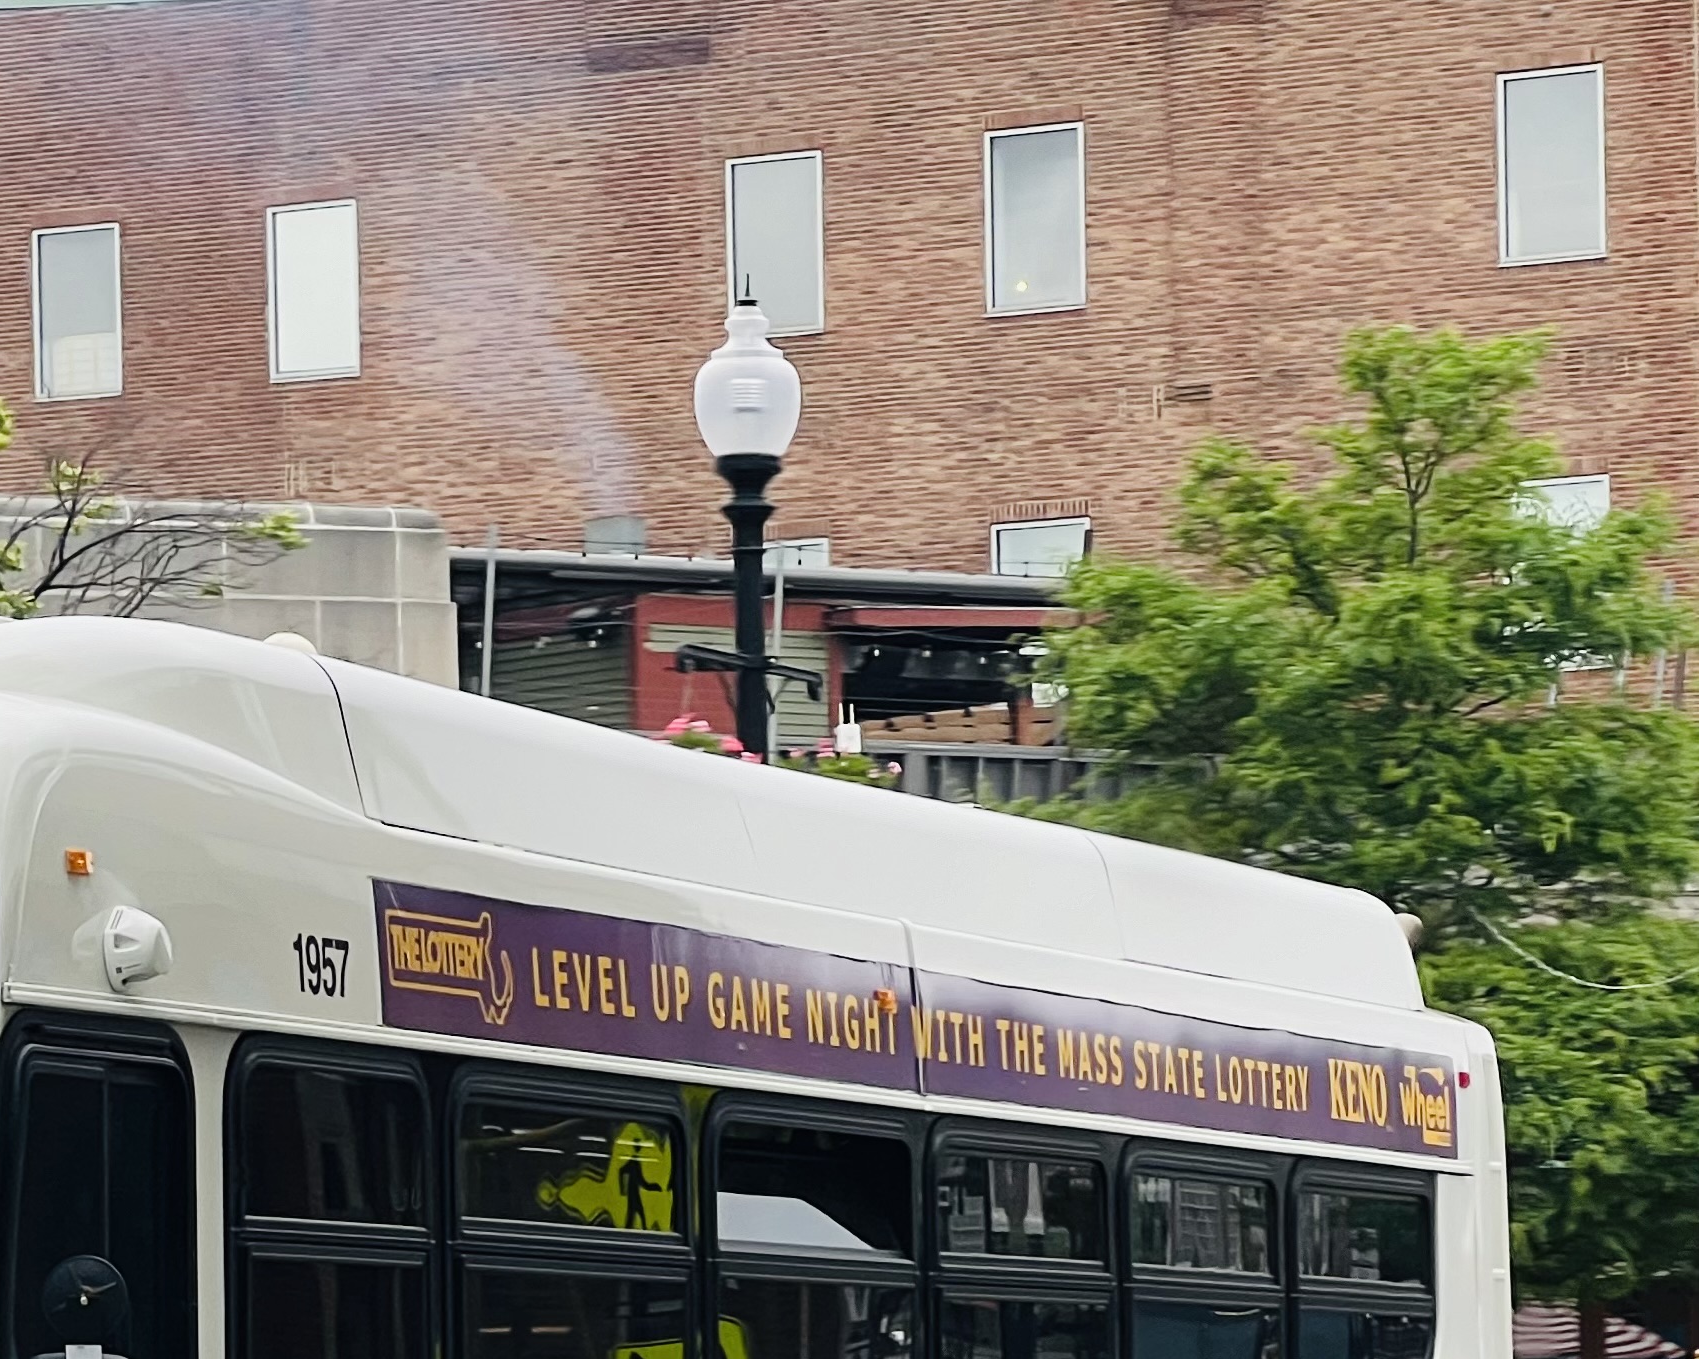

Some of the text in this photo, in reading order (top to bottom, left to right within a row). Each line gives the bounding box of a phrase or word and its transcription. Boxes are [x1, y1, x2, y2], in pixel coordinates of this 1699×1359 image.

[293, 933, 349, 997] 1957
[389, 924, 484, 980] THE LOTTERY
[531, 946, 1452, 1138] LEVEL UP GAME NIGHT WITH THE MASS STATE LOTTERY KENO Wheel
